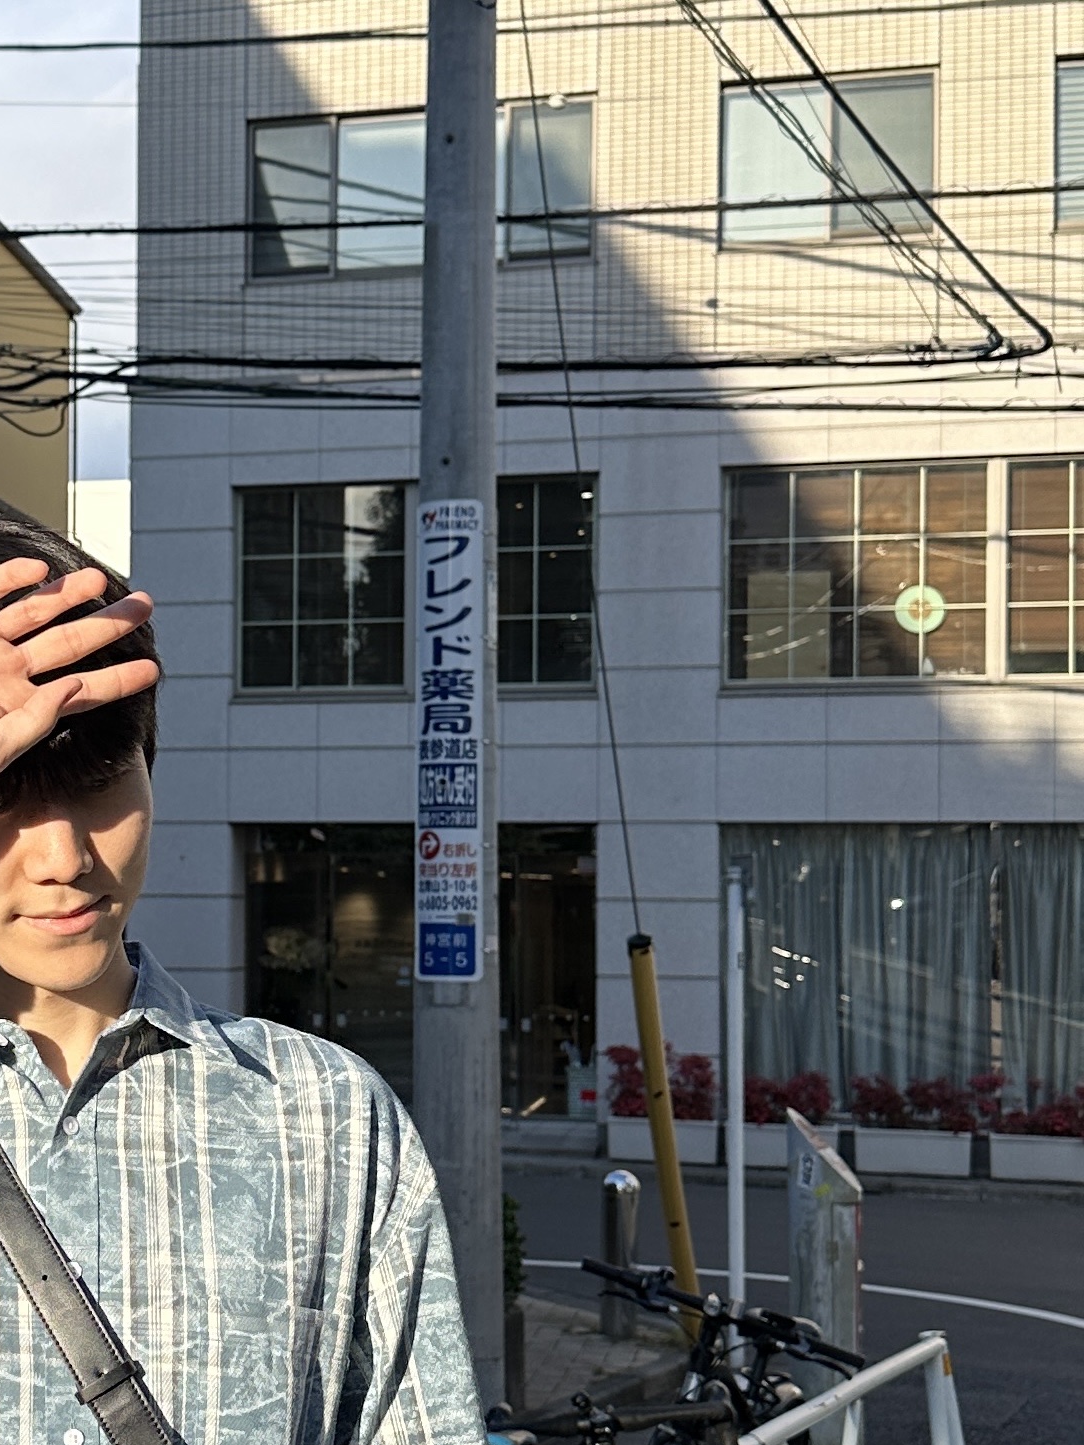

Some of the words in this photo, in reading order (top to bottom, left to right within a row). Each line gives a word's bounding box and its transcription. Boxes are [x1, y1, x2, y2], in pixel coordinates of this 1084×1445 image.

[422, 536, 474, 736] フレンド薬局
[425, 932, 468, 949] 神宮前
